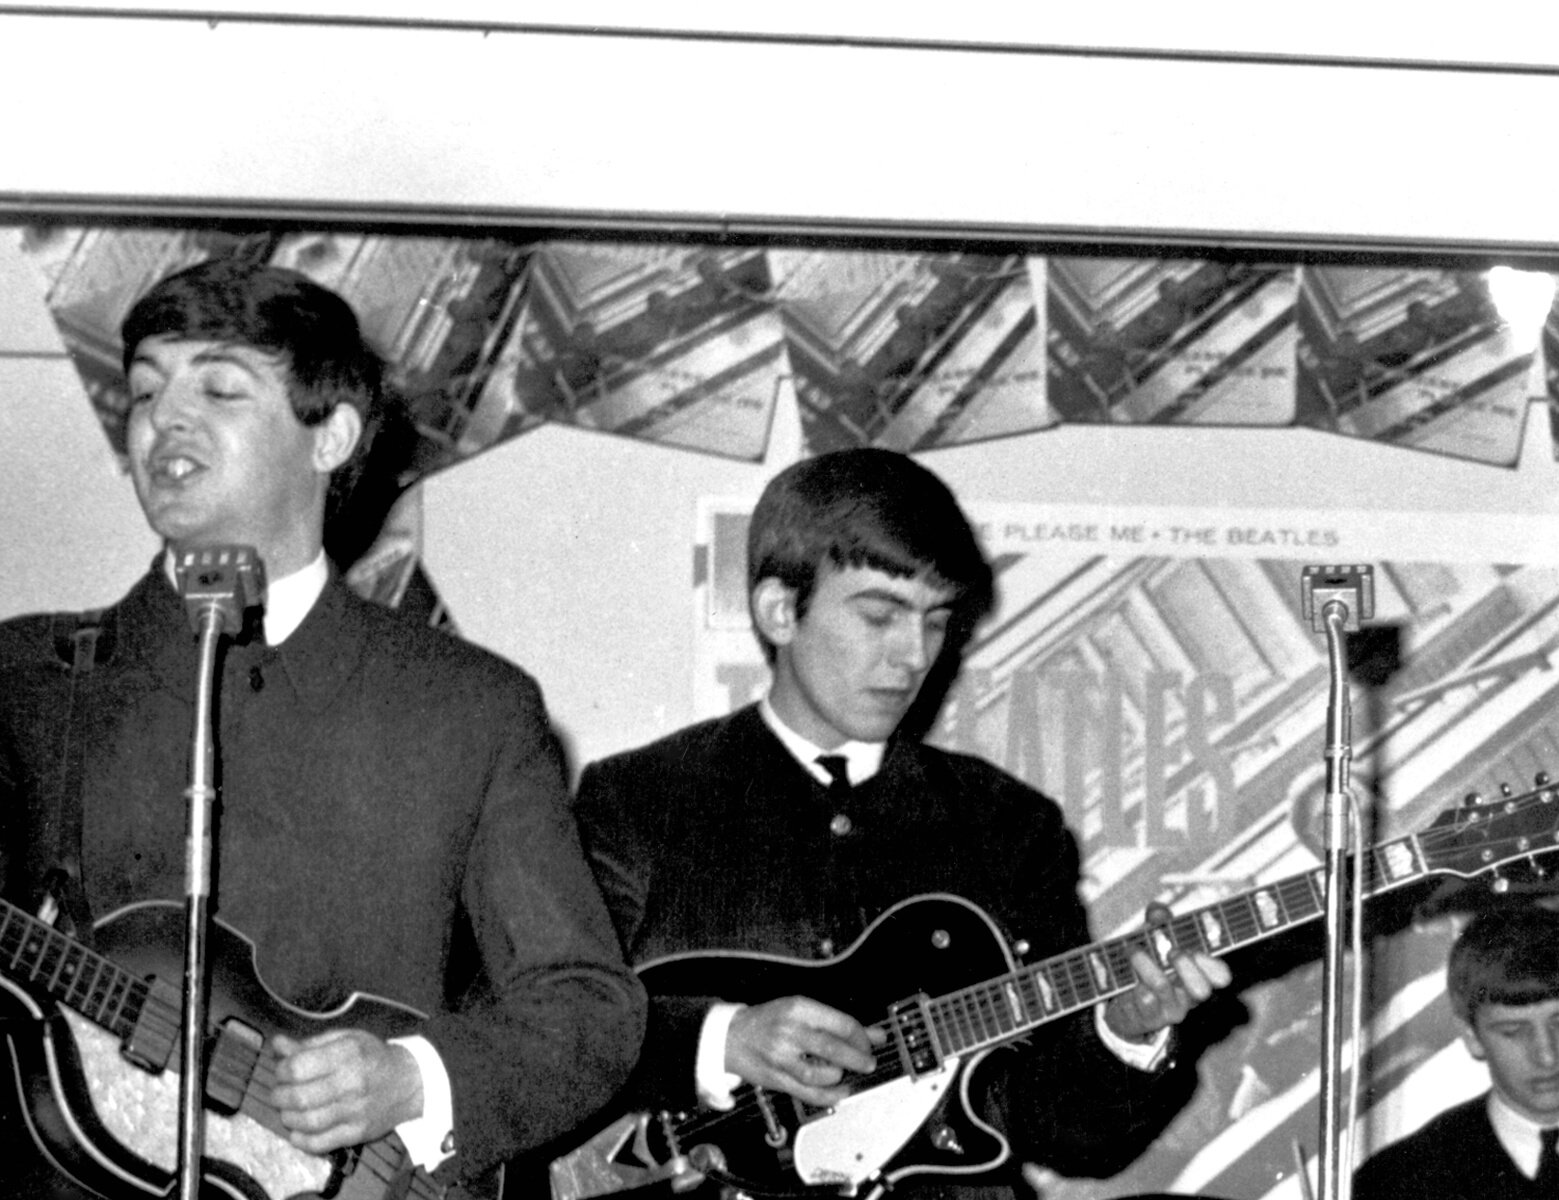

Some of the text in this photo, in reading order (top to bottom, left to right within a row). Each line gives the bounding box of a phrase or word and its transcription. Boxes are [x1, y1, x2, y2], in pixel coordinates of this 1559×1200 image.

[1003, 524, 1099, 543] PLEASE
[1110, 526, 1144, 543] ME
[1168, 527, 1218, 545] THE
[1226, 527, 1340, 547] BEATLES
